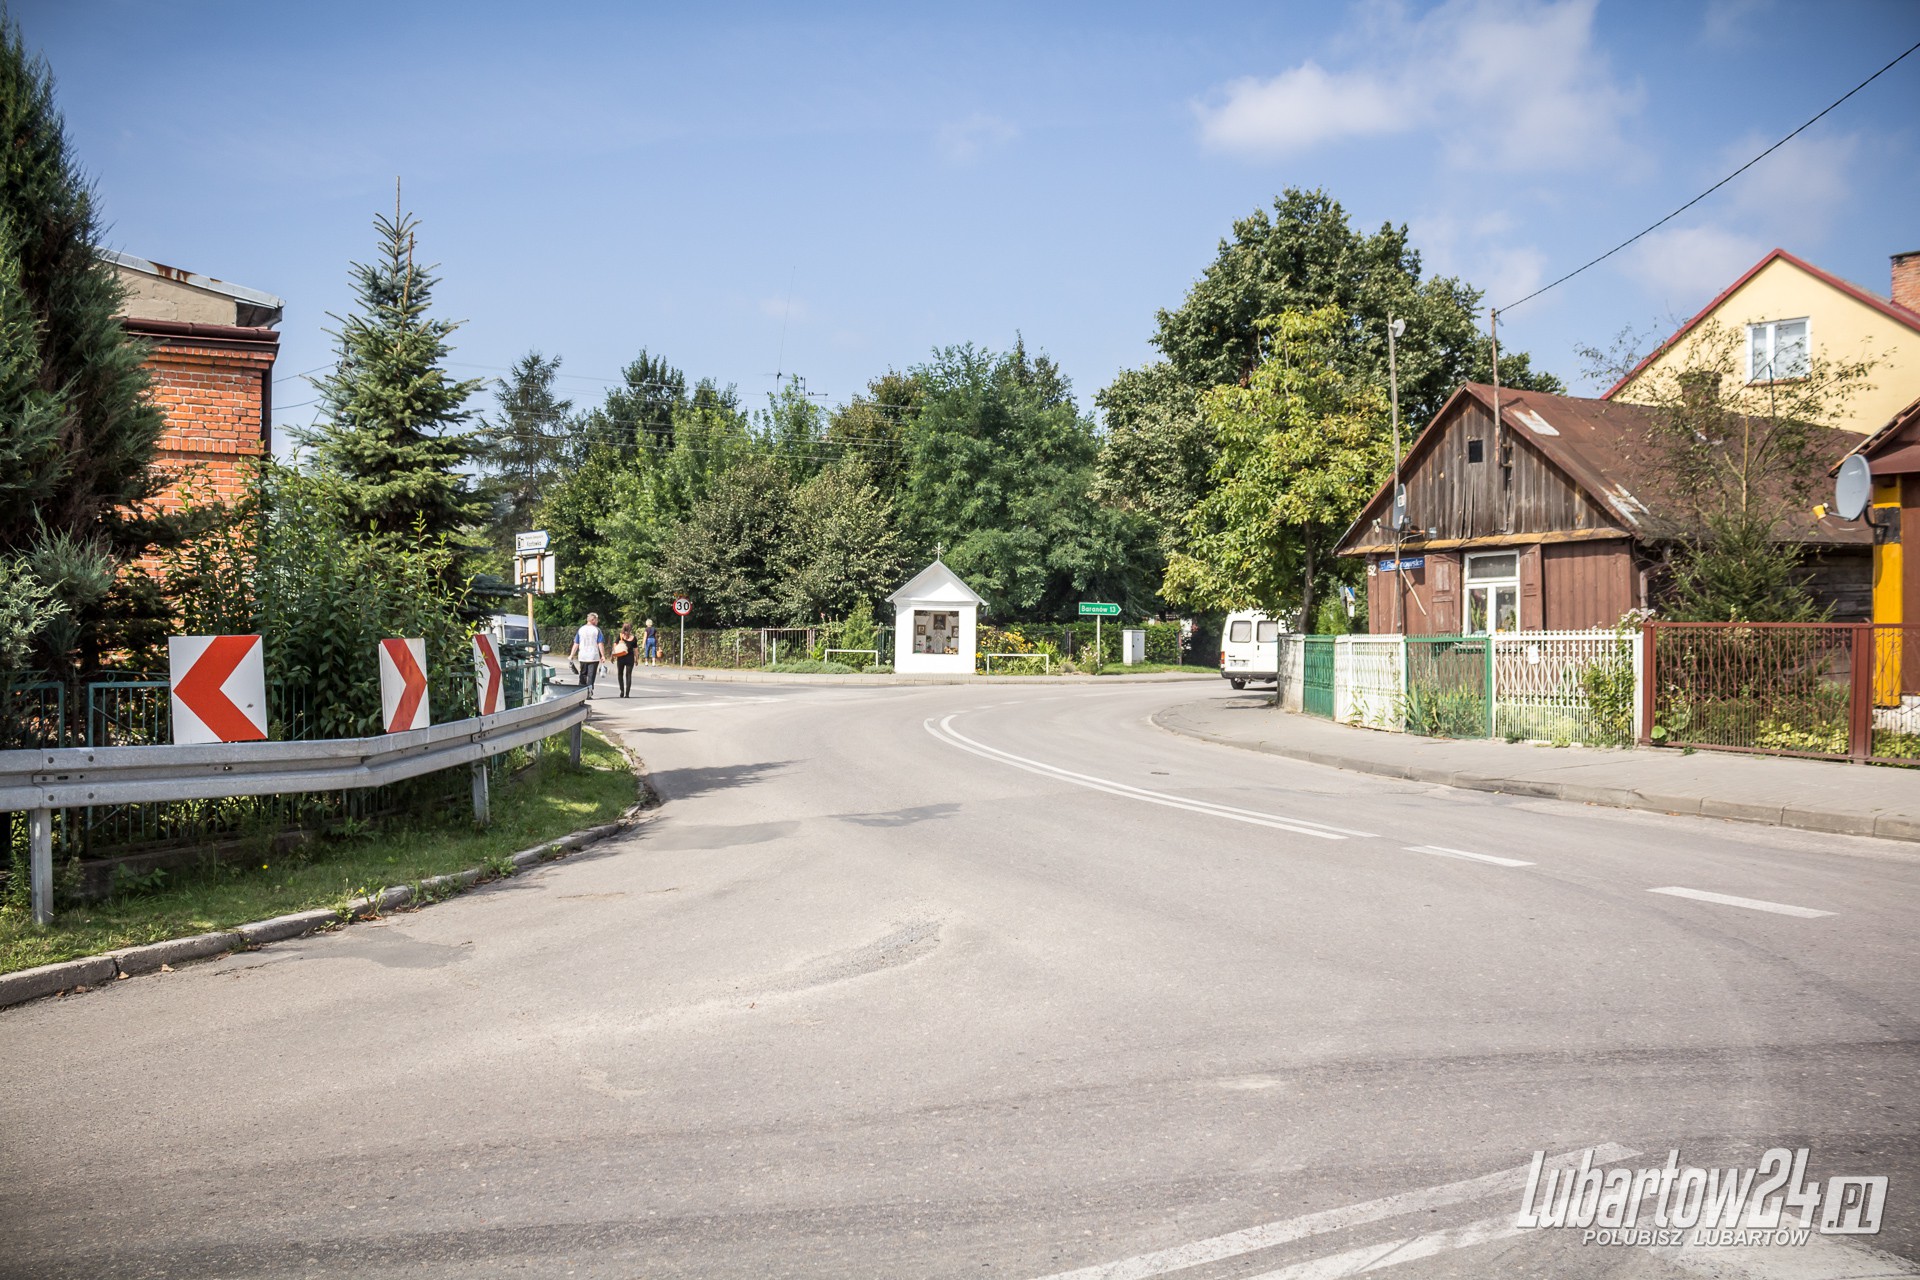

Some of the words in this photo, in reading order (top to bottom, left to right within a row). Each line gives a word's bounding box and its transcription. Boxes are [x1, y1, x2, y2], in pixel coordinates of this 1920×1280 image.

[1367, 564, 1377, 577] 52
[676, 601, 690, 611] 30
[1081, 605, 1108, 613] Baranów
